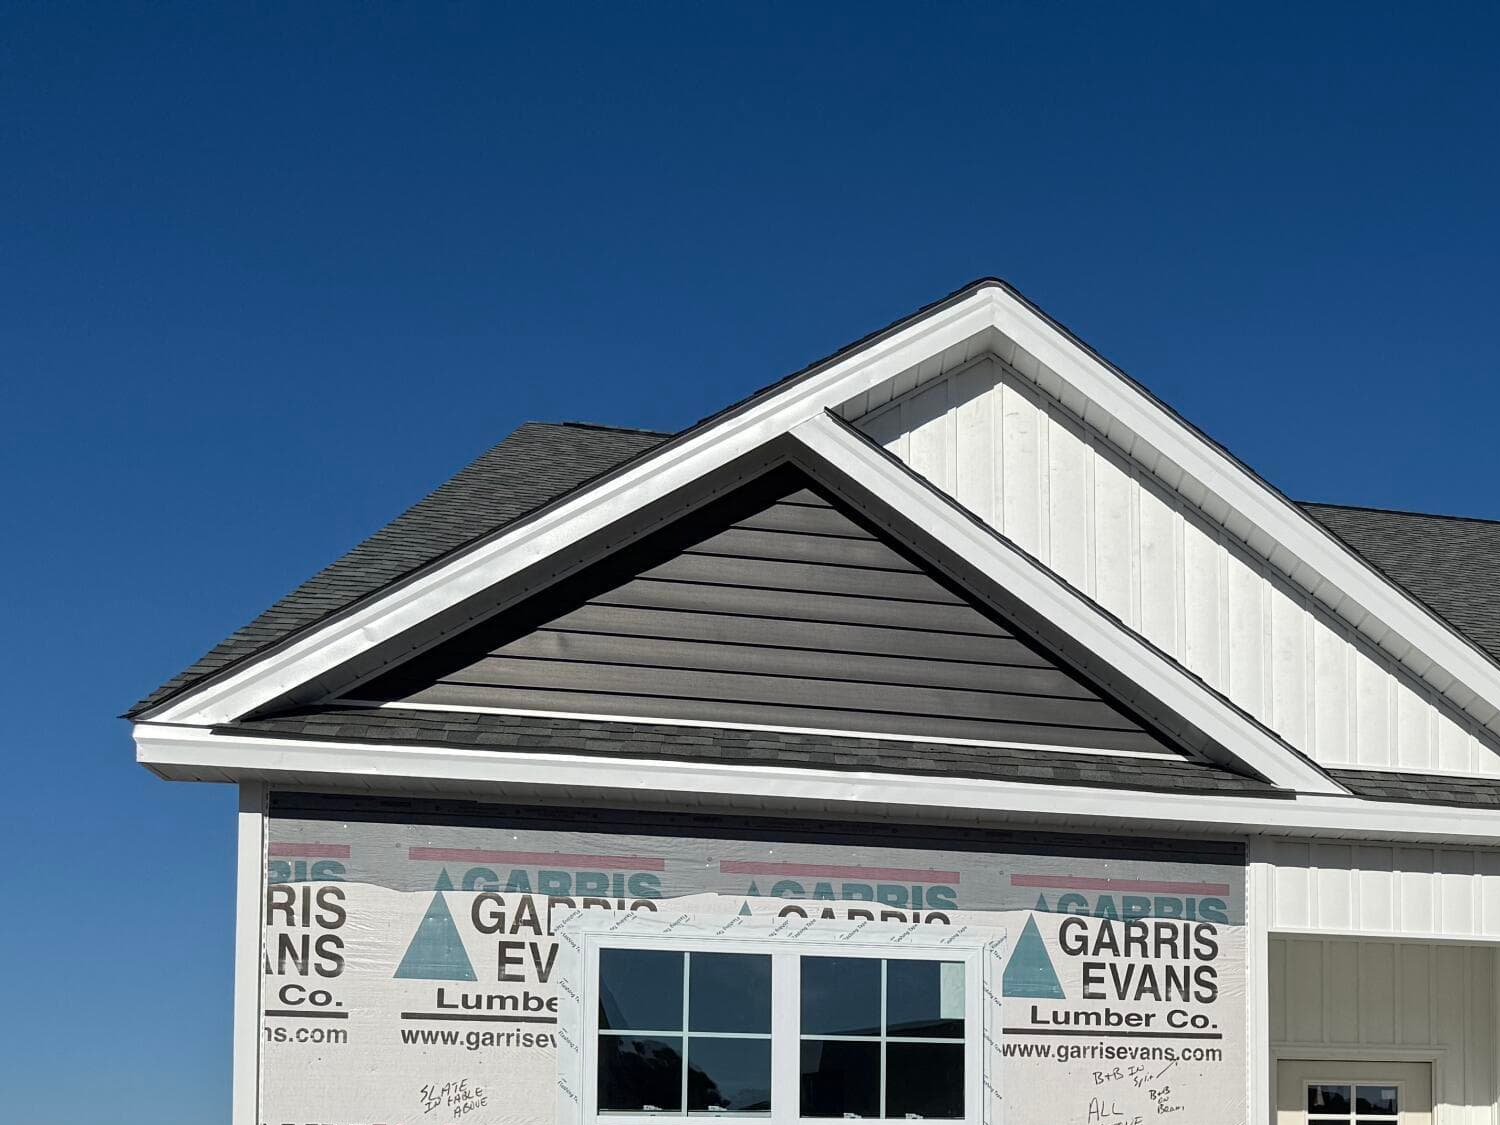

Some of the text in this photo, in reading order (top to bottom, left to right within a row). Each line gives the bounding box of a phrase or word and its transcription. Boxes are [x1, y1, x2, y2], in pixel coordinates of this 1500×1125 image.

[1058, 917, 1219, 961] GARRIS
[266, 933, 345, 978] NS
[498, 939, 559, 983] EV
[278, 984, 343, 1006] Co.
[1082, 961, 1219, 1004] EVANS
[1031, 1005, 1218, 1029] Lumber Co.
[1002, 1041, 1222, 1063] www.garrisevans.com
[420, 1079, 468, 1103] SLATE
[1088, 1097, 1124, 1123] ALL
